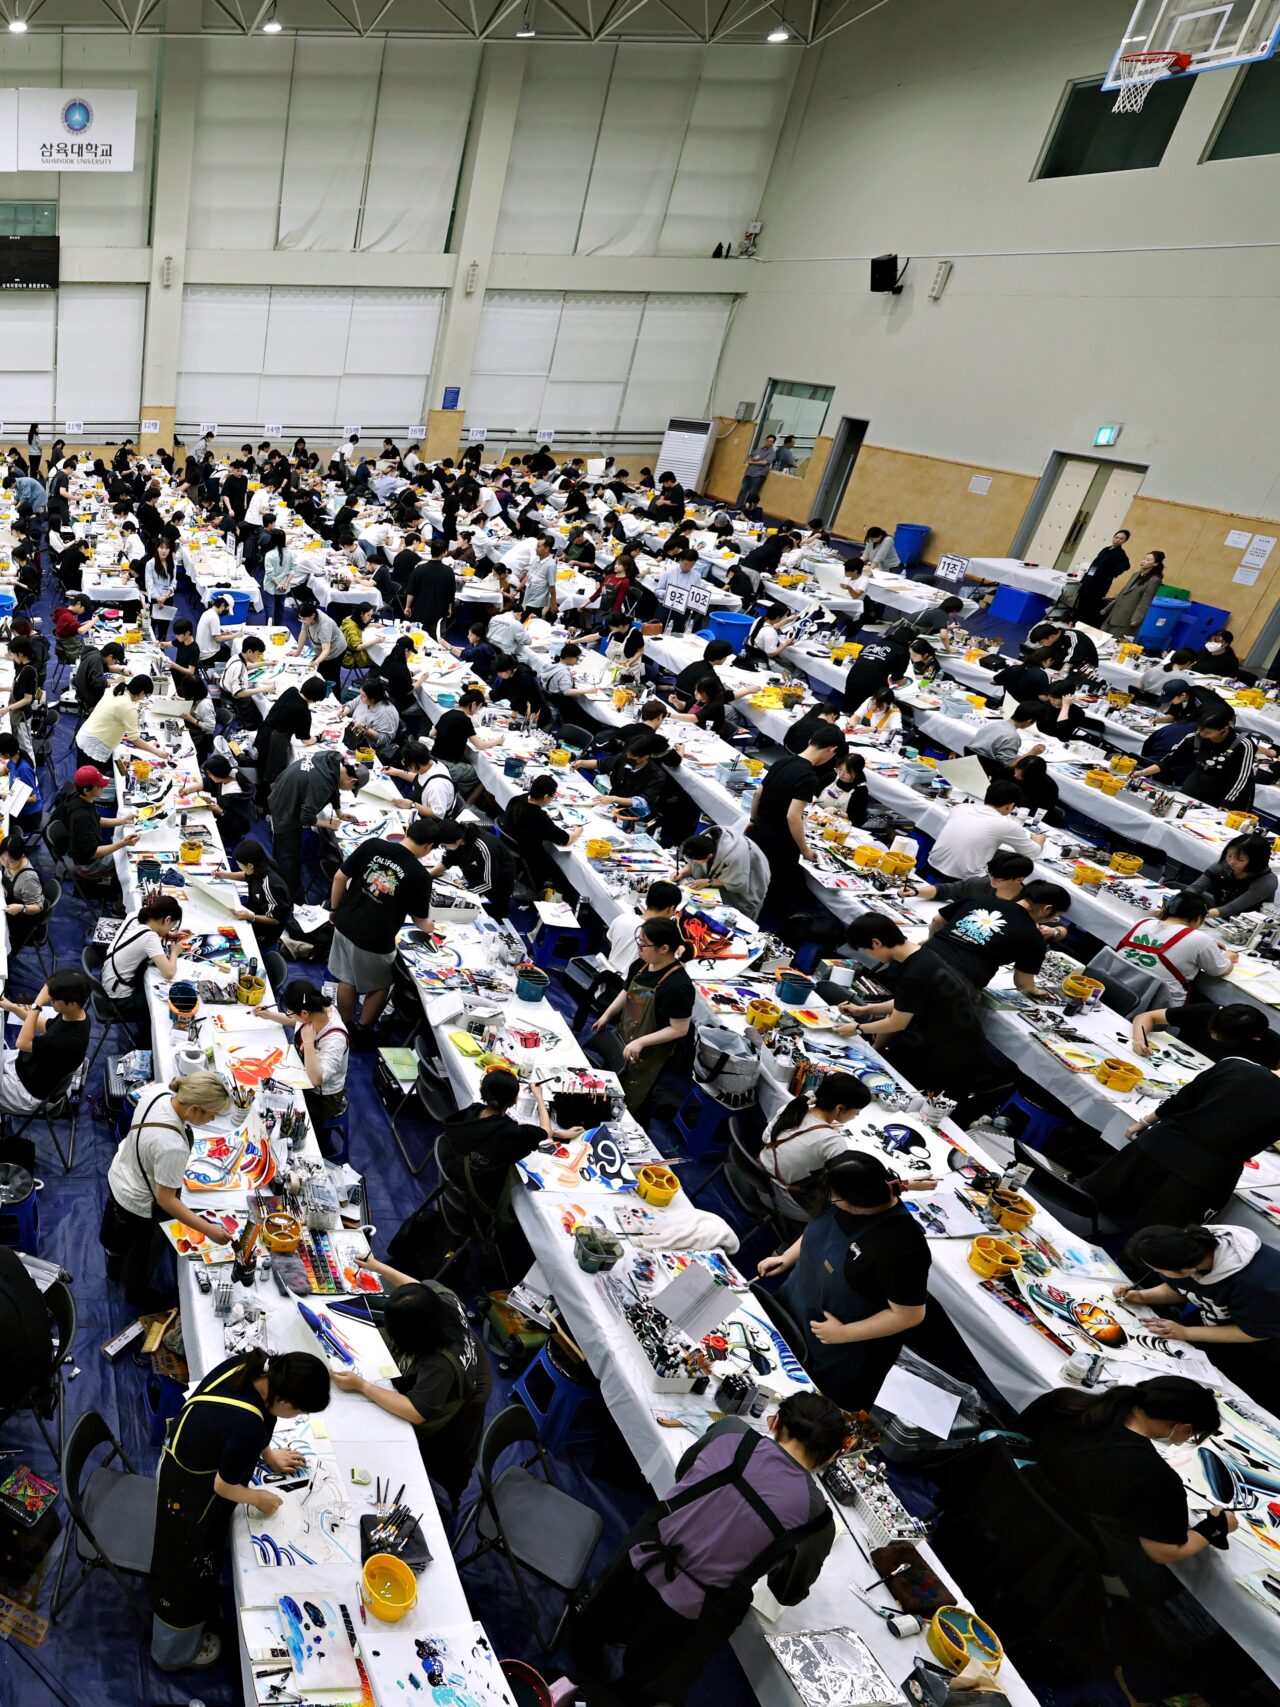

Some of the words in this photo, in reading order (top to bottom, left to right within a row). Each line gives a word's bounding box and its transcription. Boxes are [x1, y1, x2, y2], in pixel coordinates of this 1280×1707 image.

[39, 142, 113, 158] 삼육대학교
[143, 421, 157, 430] 12행
[410, 427, 424, 435] 16행
[471, 429, 485, 437] 17행
[941, 561, 958, 574] 11조
[670, 591, 684, 605] 9조
[691, 591, 708, 607] 10조
[373, 855, 405, 880] CALIFORNIA
